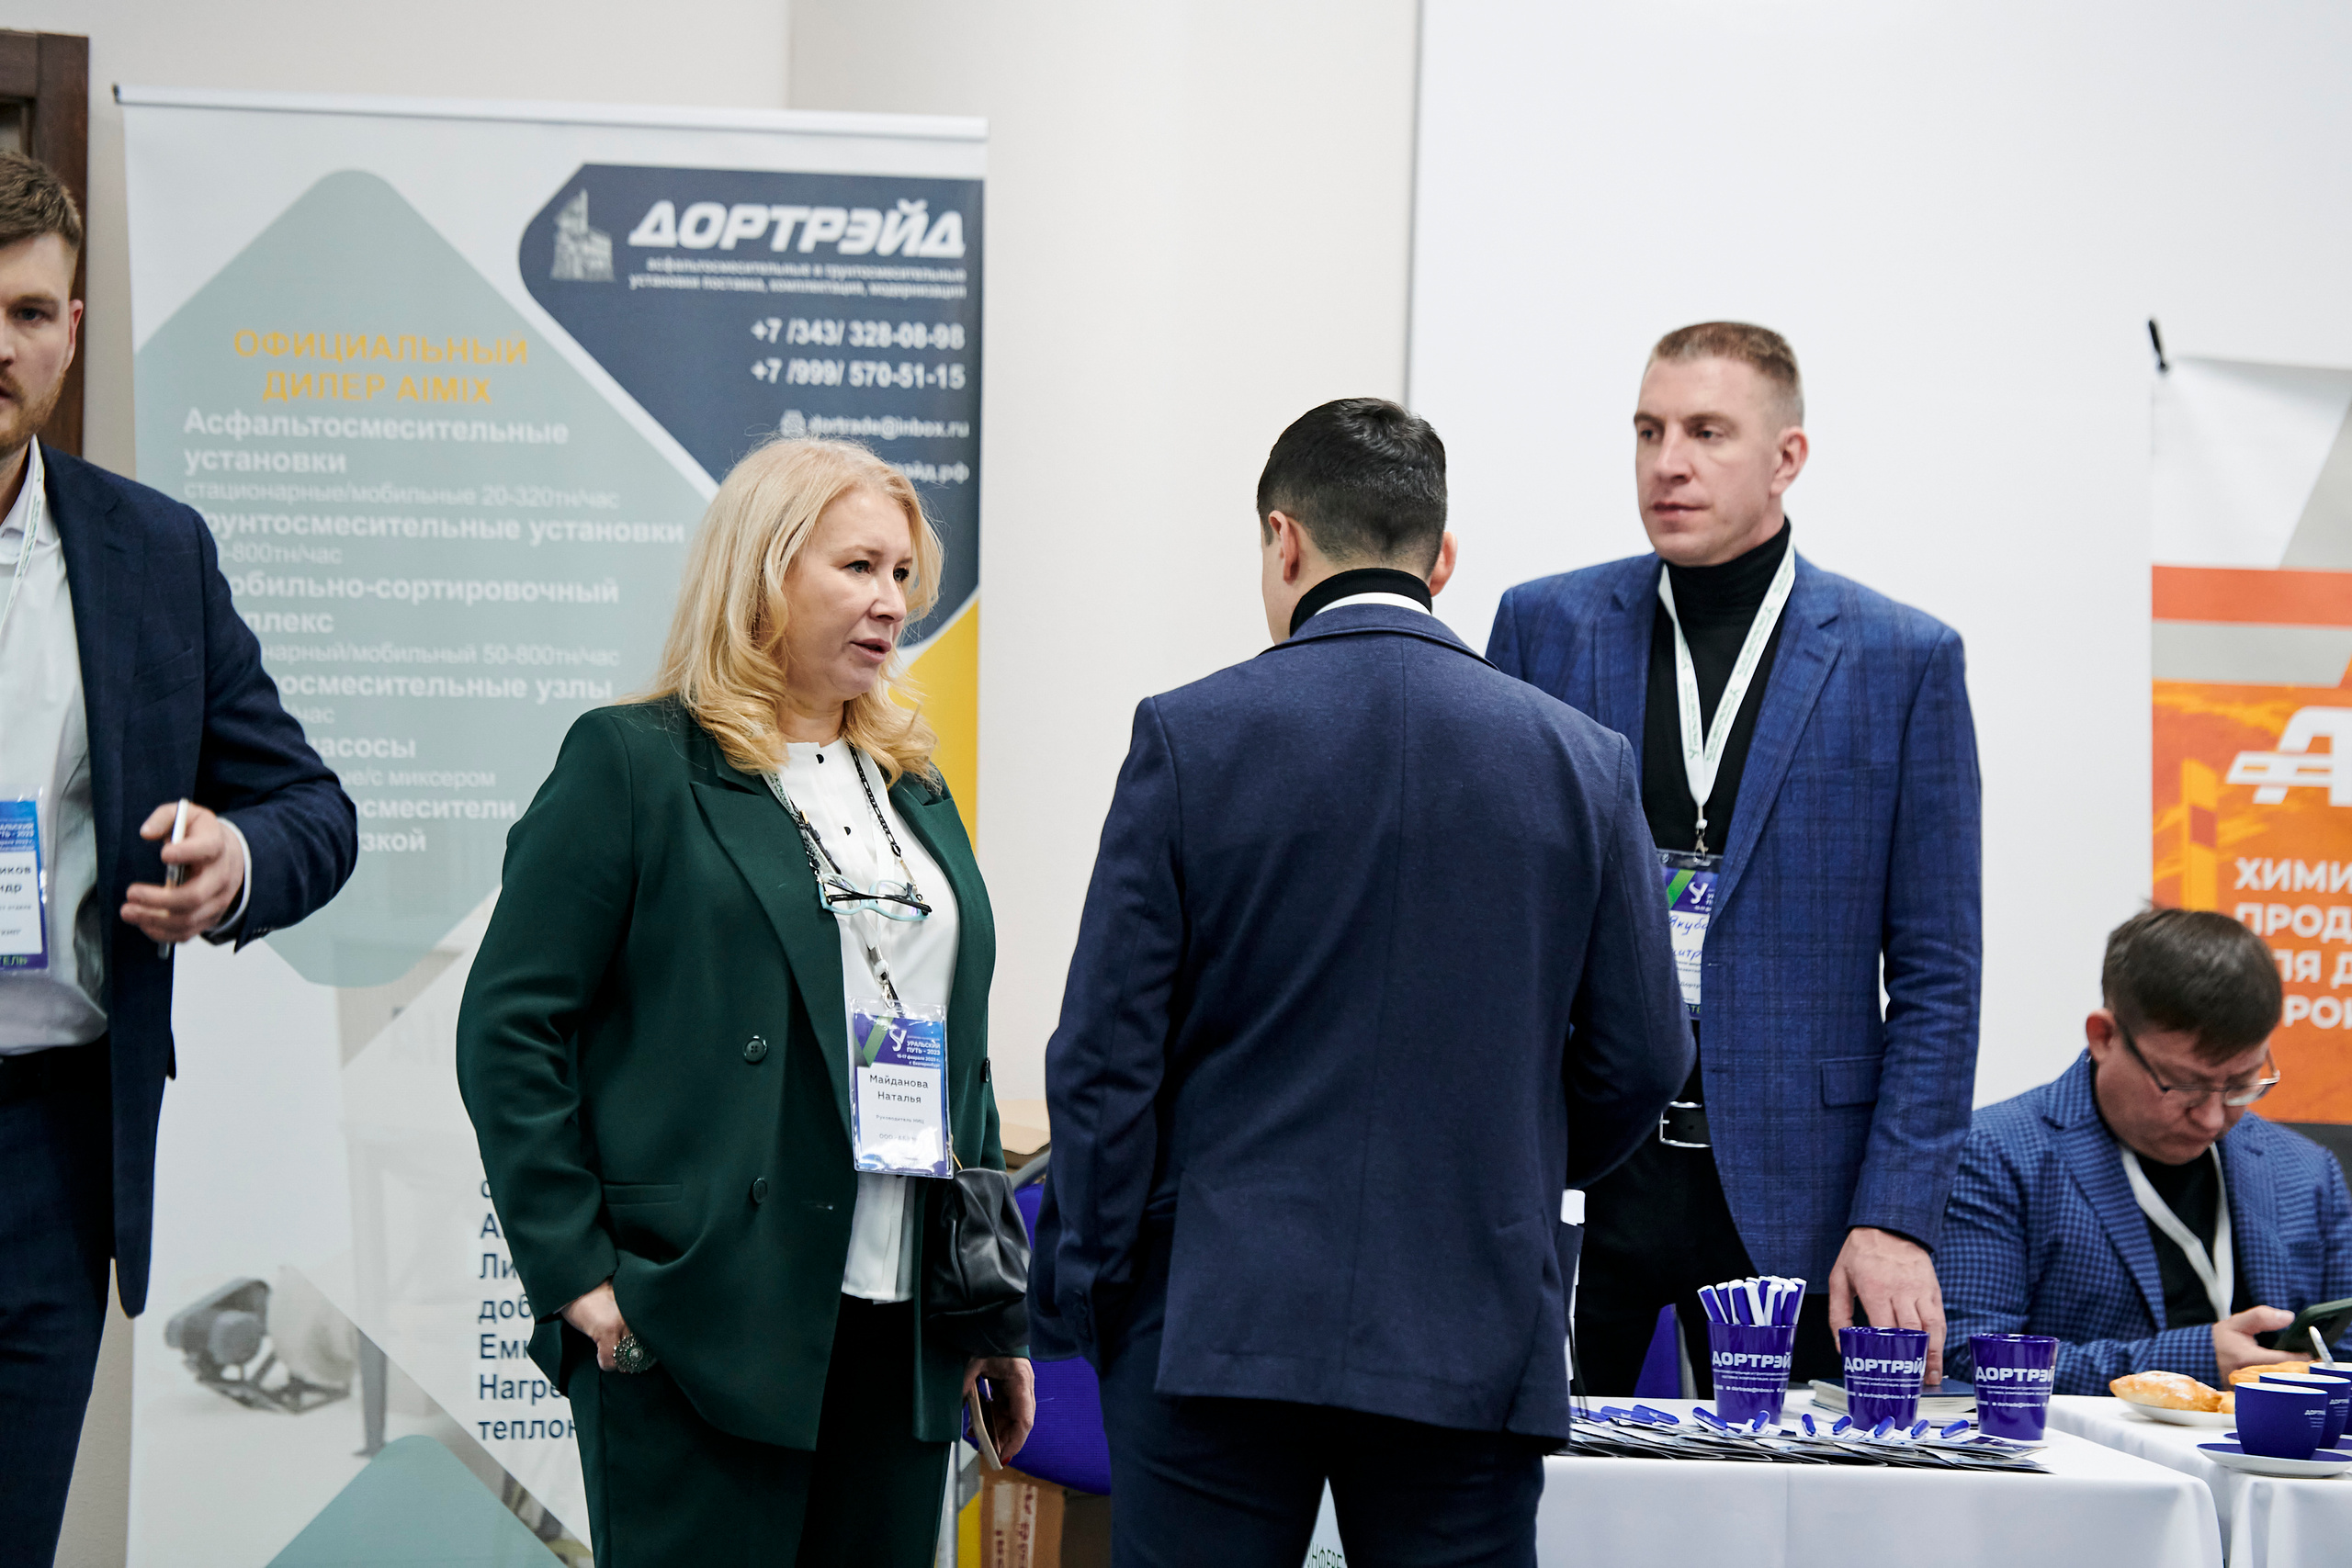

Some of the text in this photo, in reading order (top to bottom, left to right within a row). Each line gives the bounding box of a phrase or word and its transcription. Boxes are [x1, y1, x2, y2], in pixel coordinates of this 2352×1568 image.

[628, 197, 967, 259] ДОРТРЭЙД
[233, 327, 528, 366] ОФИЦИАЛЬНЫЙ
[751, 317, 967, 351] +7 /343/ 328-08-98
[262, 370, 492, 405] ДИЛЕР AIMIX
[751, 356, 967, 390] +7 /999/ 570-51-15
[183, 406, 570, 446] Асфальтосмесительные
[808, 413, 971, 441] dortrade@inbox.ru
[184, 447, 346, 478] установки
[184, 479, 476, 507] стационарные/мобильные
[198, 508, 686, 547] рунтосмесительные установки
[276, 674, 613, 705] осмесительные узлы
[388, 770, 496, 791] миксером
[869, 1074, 929, 1089] Майданова
[877, 1090, 922, 1104] Наталья
